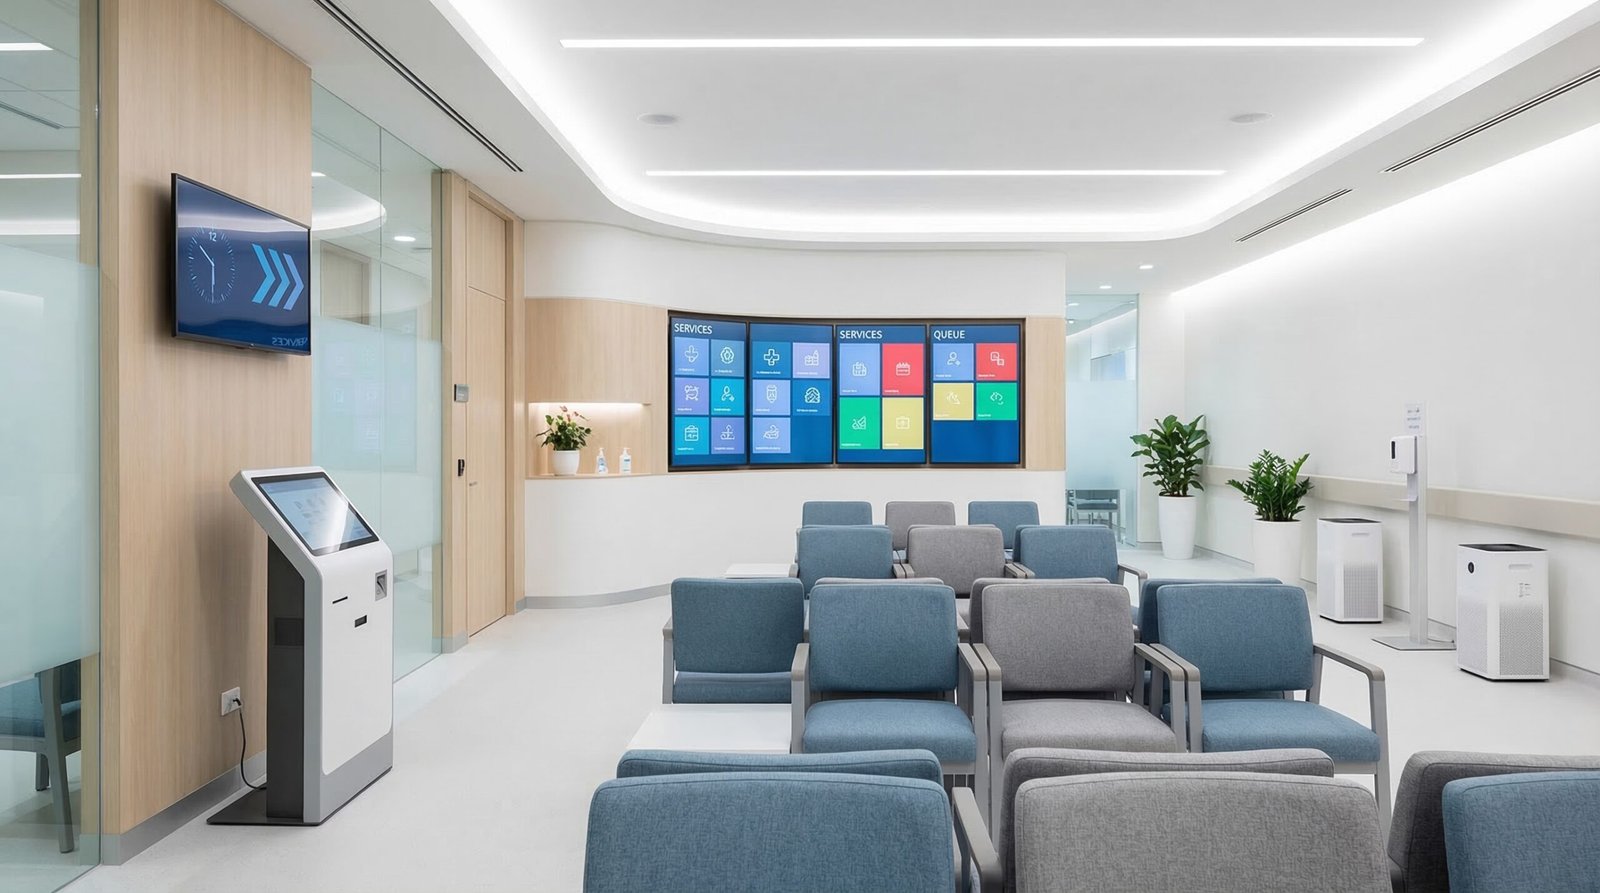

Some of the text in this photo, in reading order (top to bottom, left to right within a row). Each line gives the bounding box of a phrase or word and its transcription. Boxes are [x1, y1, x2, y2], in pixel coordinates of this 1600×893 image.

[209, 231, 217, 242] 12
[674, 323, 713, 335] SERVICES
[839, 330, 883, 340] SERVICES
[933, 330, 966, 341] QUEUE
